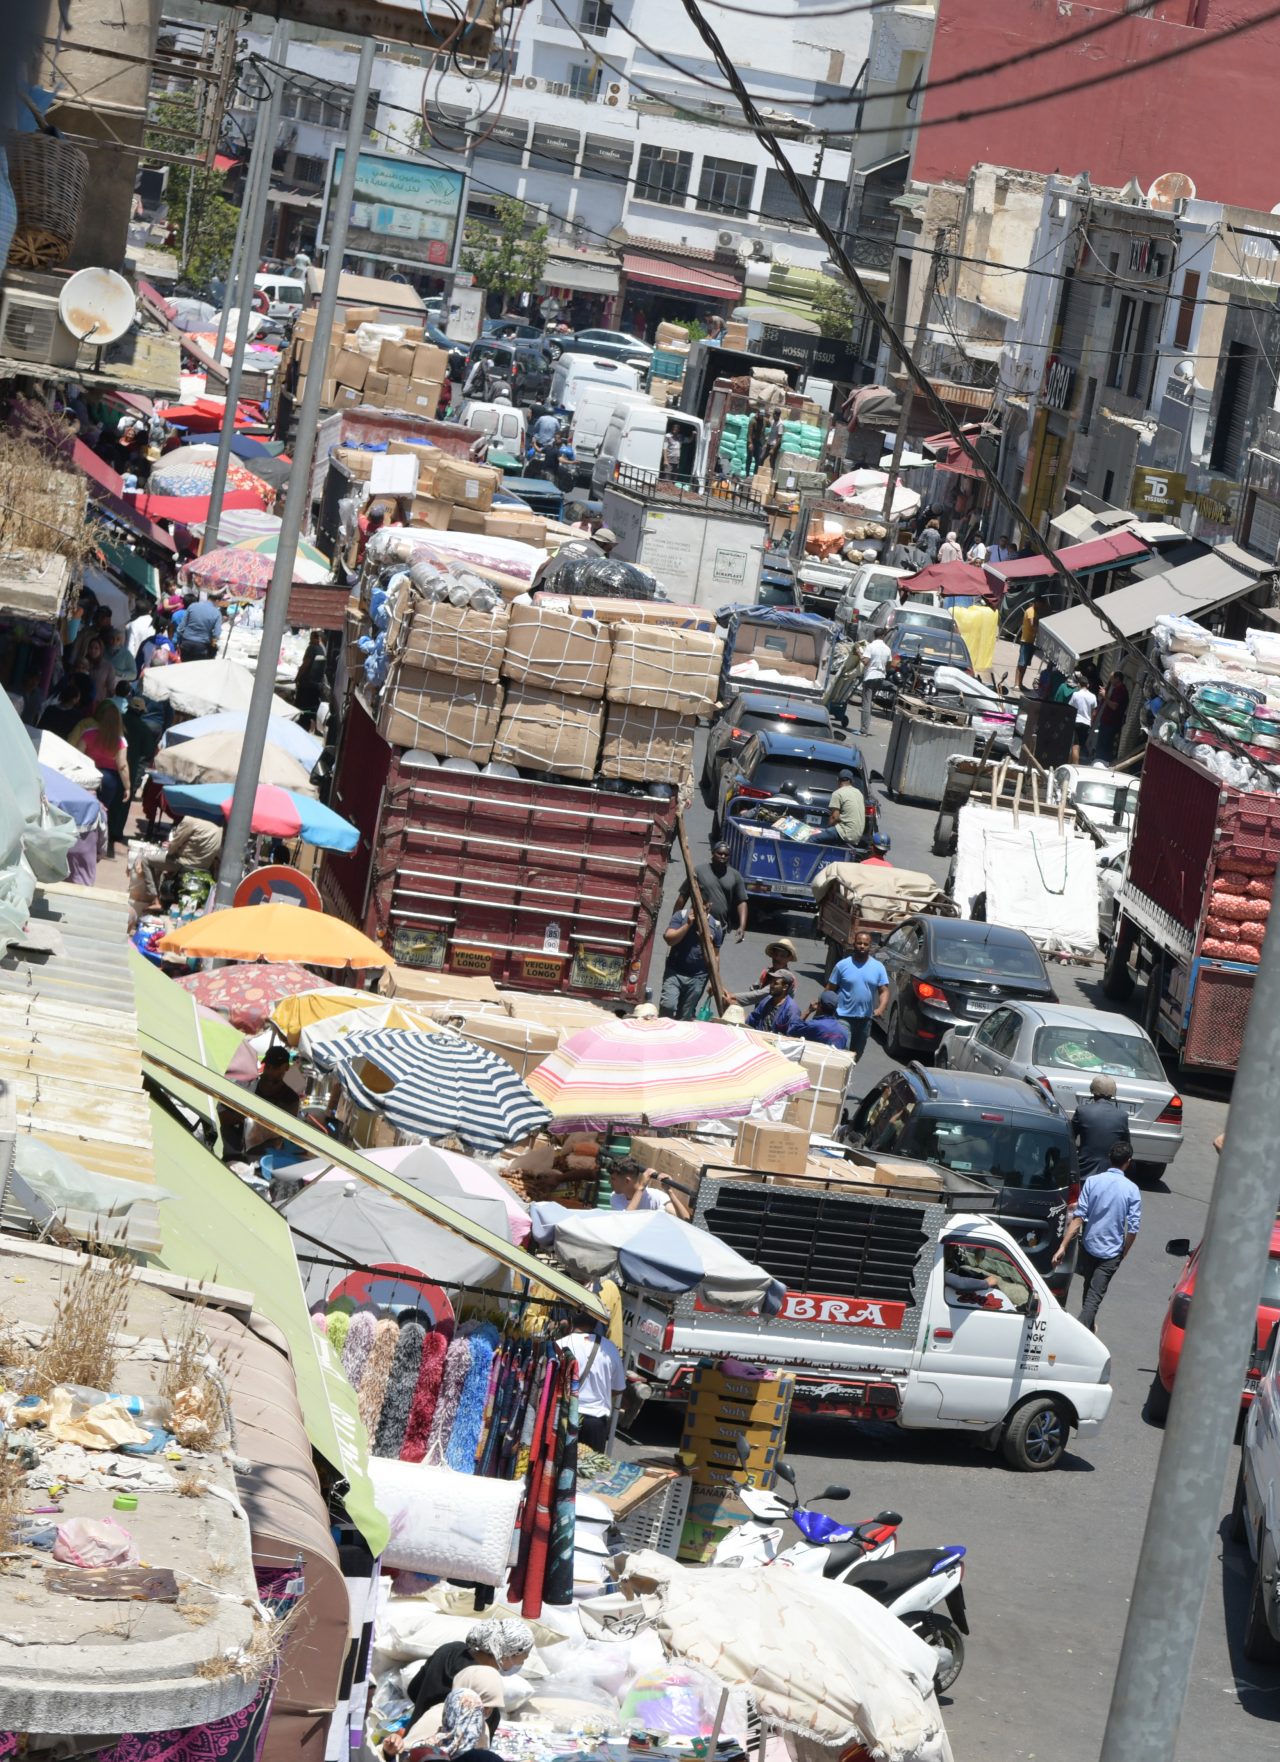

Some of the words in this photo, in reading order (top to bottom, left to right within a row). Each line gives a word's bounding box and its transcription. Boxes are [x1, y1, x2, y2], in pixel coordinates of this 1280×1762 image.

[782, 346, 809, 360] HOSSIN
[455, 951, 492, 963] VEICULO
[457, 960, 487, 970] LONGO
[524, 960, 561, 972] VEICULO
[526, 969, 557, 979] LONGO
[783, 1297, 886, 1326] BRA
[1028, 1320, 1047, 1331] JVC
[1026, 1333, 1045, 1343] NGK
[693, 1486, 739, 1501] BANANAS
